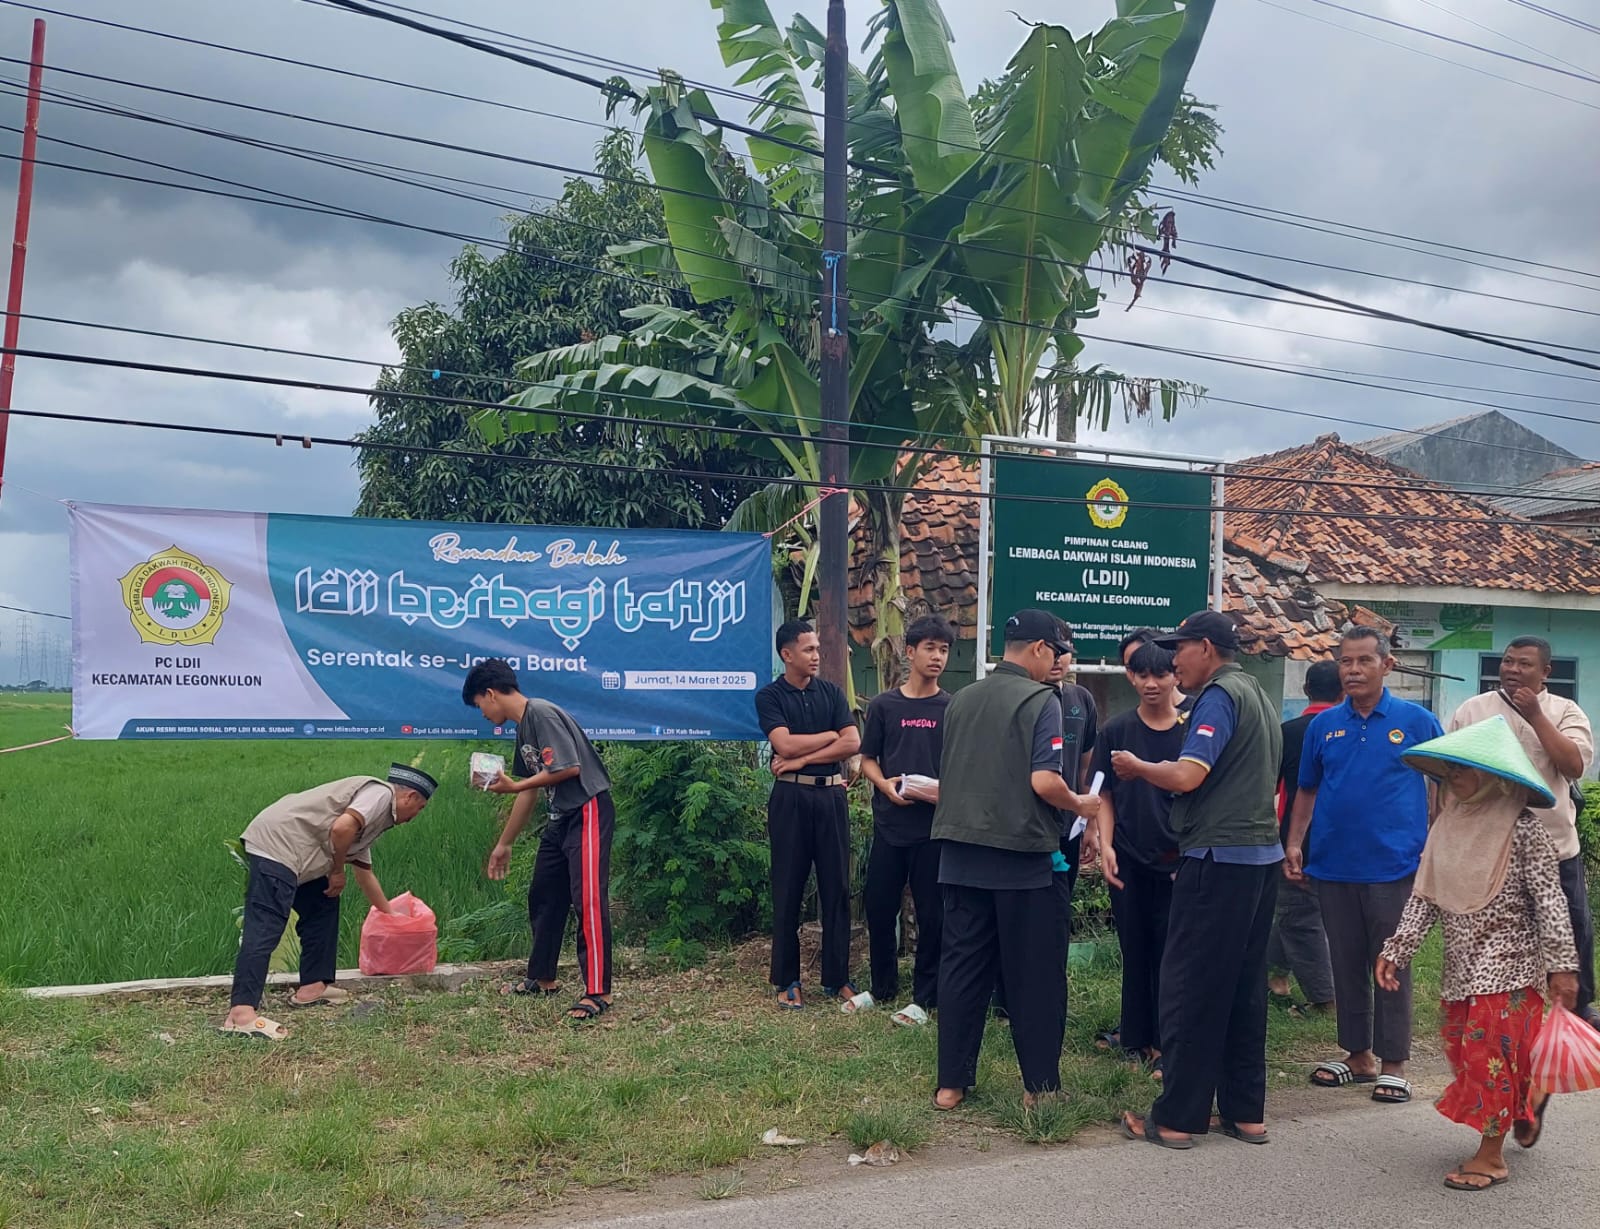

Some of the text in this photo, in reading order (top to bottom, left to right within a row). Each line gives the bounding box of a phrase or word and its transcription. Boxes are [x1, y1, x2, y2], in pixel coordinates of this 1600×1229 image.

[429, 532, 627, 568] Ramadan Berkah
[1064, 536, 1149, 550] PIMPINAN CABANG
[1009, 547, 1197, 569] LEMBAGA DAKWAH ISLAM INDONESIA
[142, 560, 178, 577] DAKWAH
[180, 561, 206, 576] ISLAM
[1081, 568, 1130, 590] (LDII)
[1036, 591, 1171, 607] KECAMATAN LEGONKULON
[155, 656, 201, 669] PC LDII
[307, 648, 414, 667] Serentak
[527, 654, 588, 672] Barat
[92, 673, 262, 687] KECAMATAN LEGONKULON
[634, 675, 747, 686] Jumat, 14 Maret 2025
